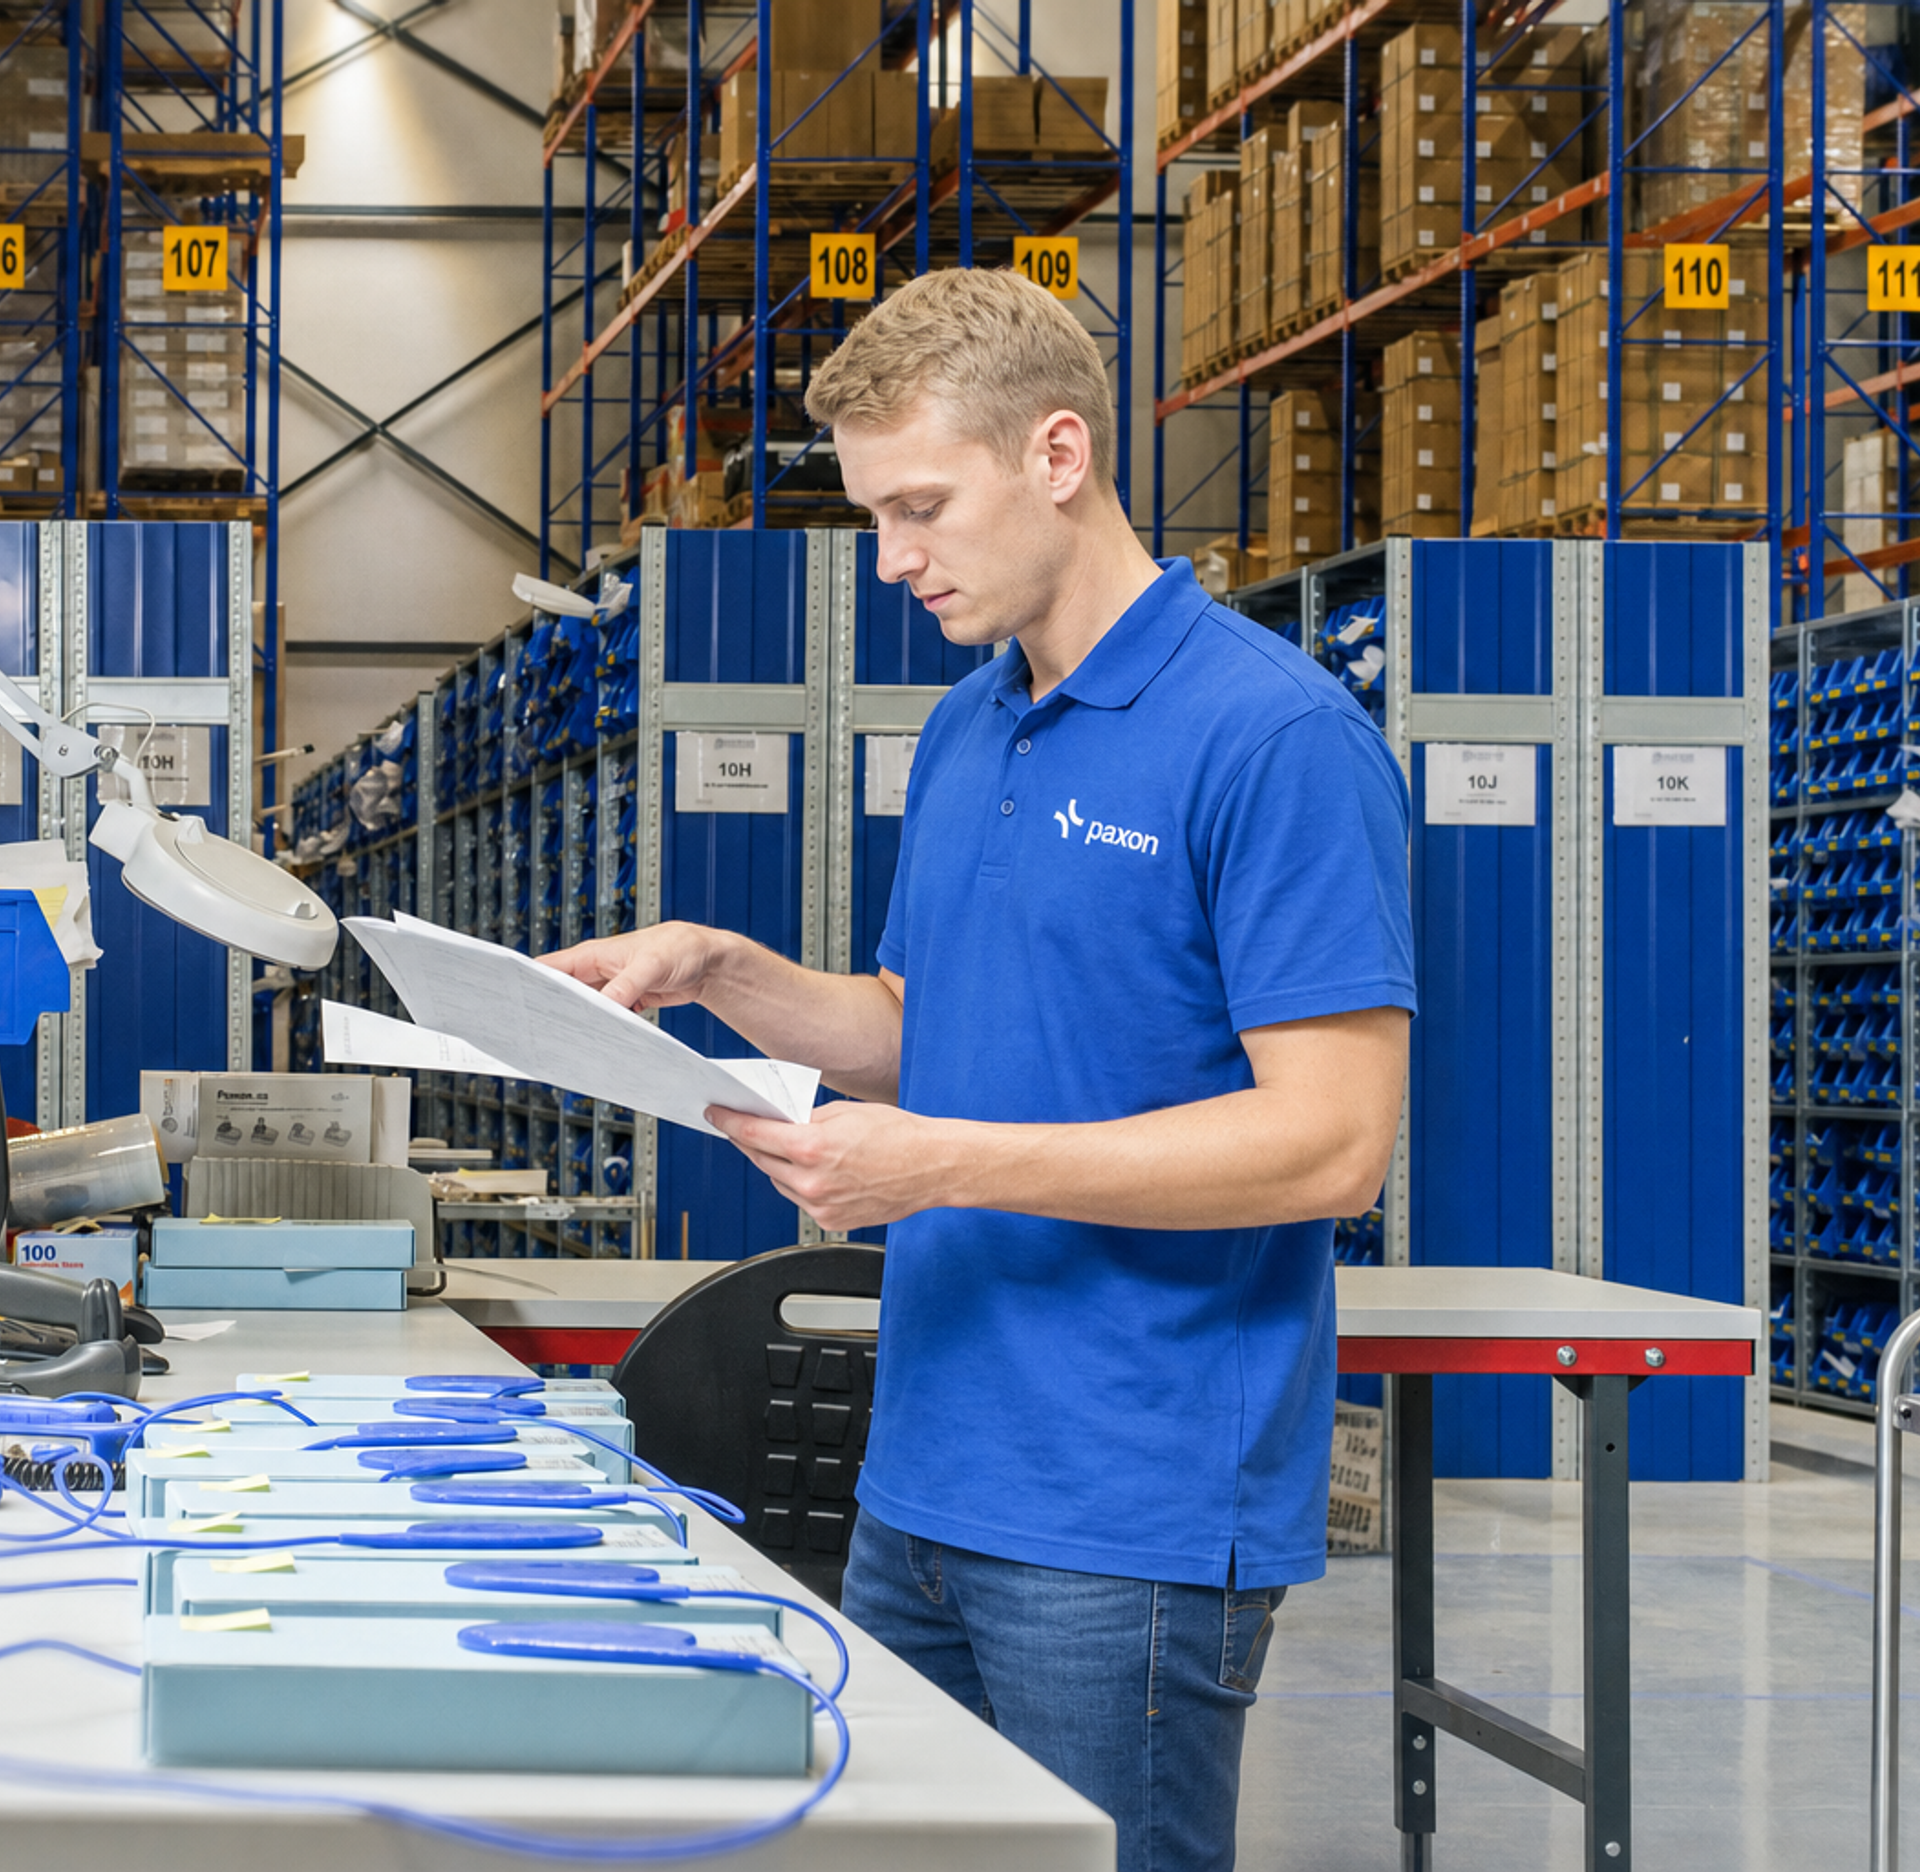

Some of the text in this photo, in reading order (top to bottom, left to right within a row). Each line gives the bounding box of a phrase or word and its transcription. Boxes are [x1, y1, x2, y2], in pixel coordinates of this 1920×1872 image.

[170, 239, 220, 277] 107
[818, 246, 868, 285] 108
[1020, 249, 1071, 289] 109
[1672, 257, 1723, 296] 110
[1877, 259, 1920, 298] 111
[718, 762, 752, 778] 10H
[1468, 774, 1498, 790] 10J
[1657, 775, 1690, 791] 10K
[1084, 820, 1159, 856] paxon
[21, 1244, 57, 1262] 100
